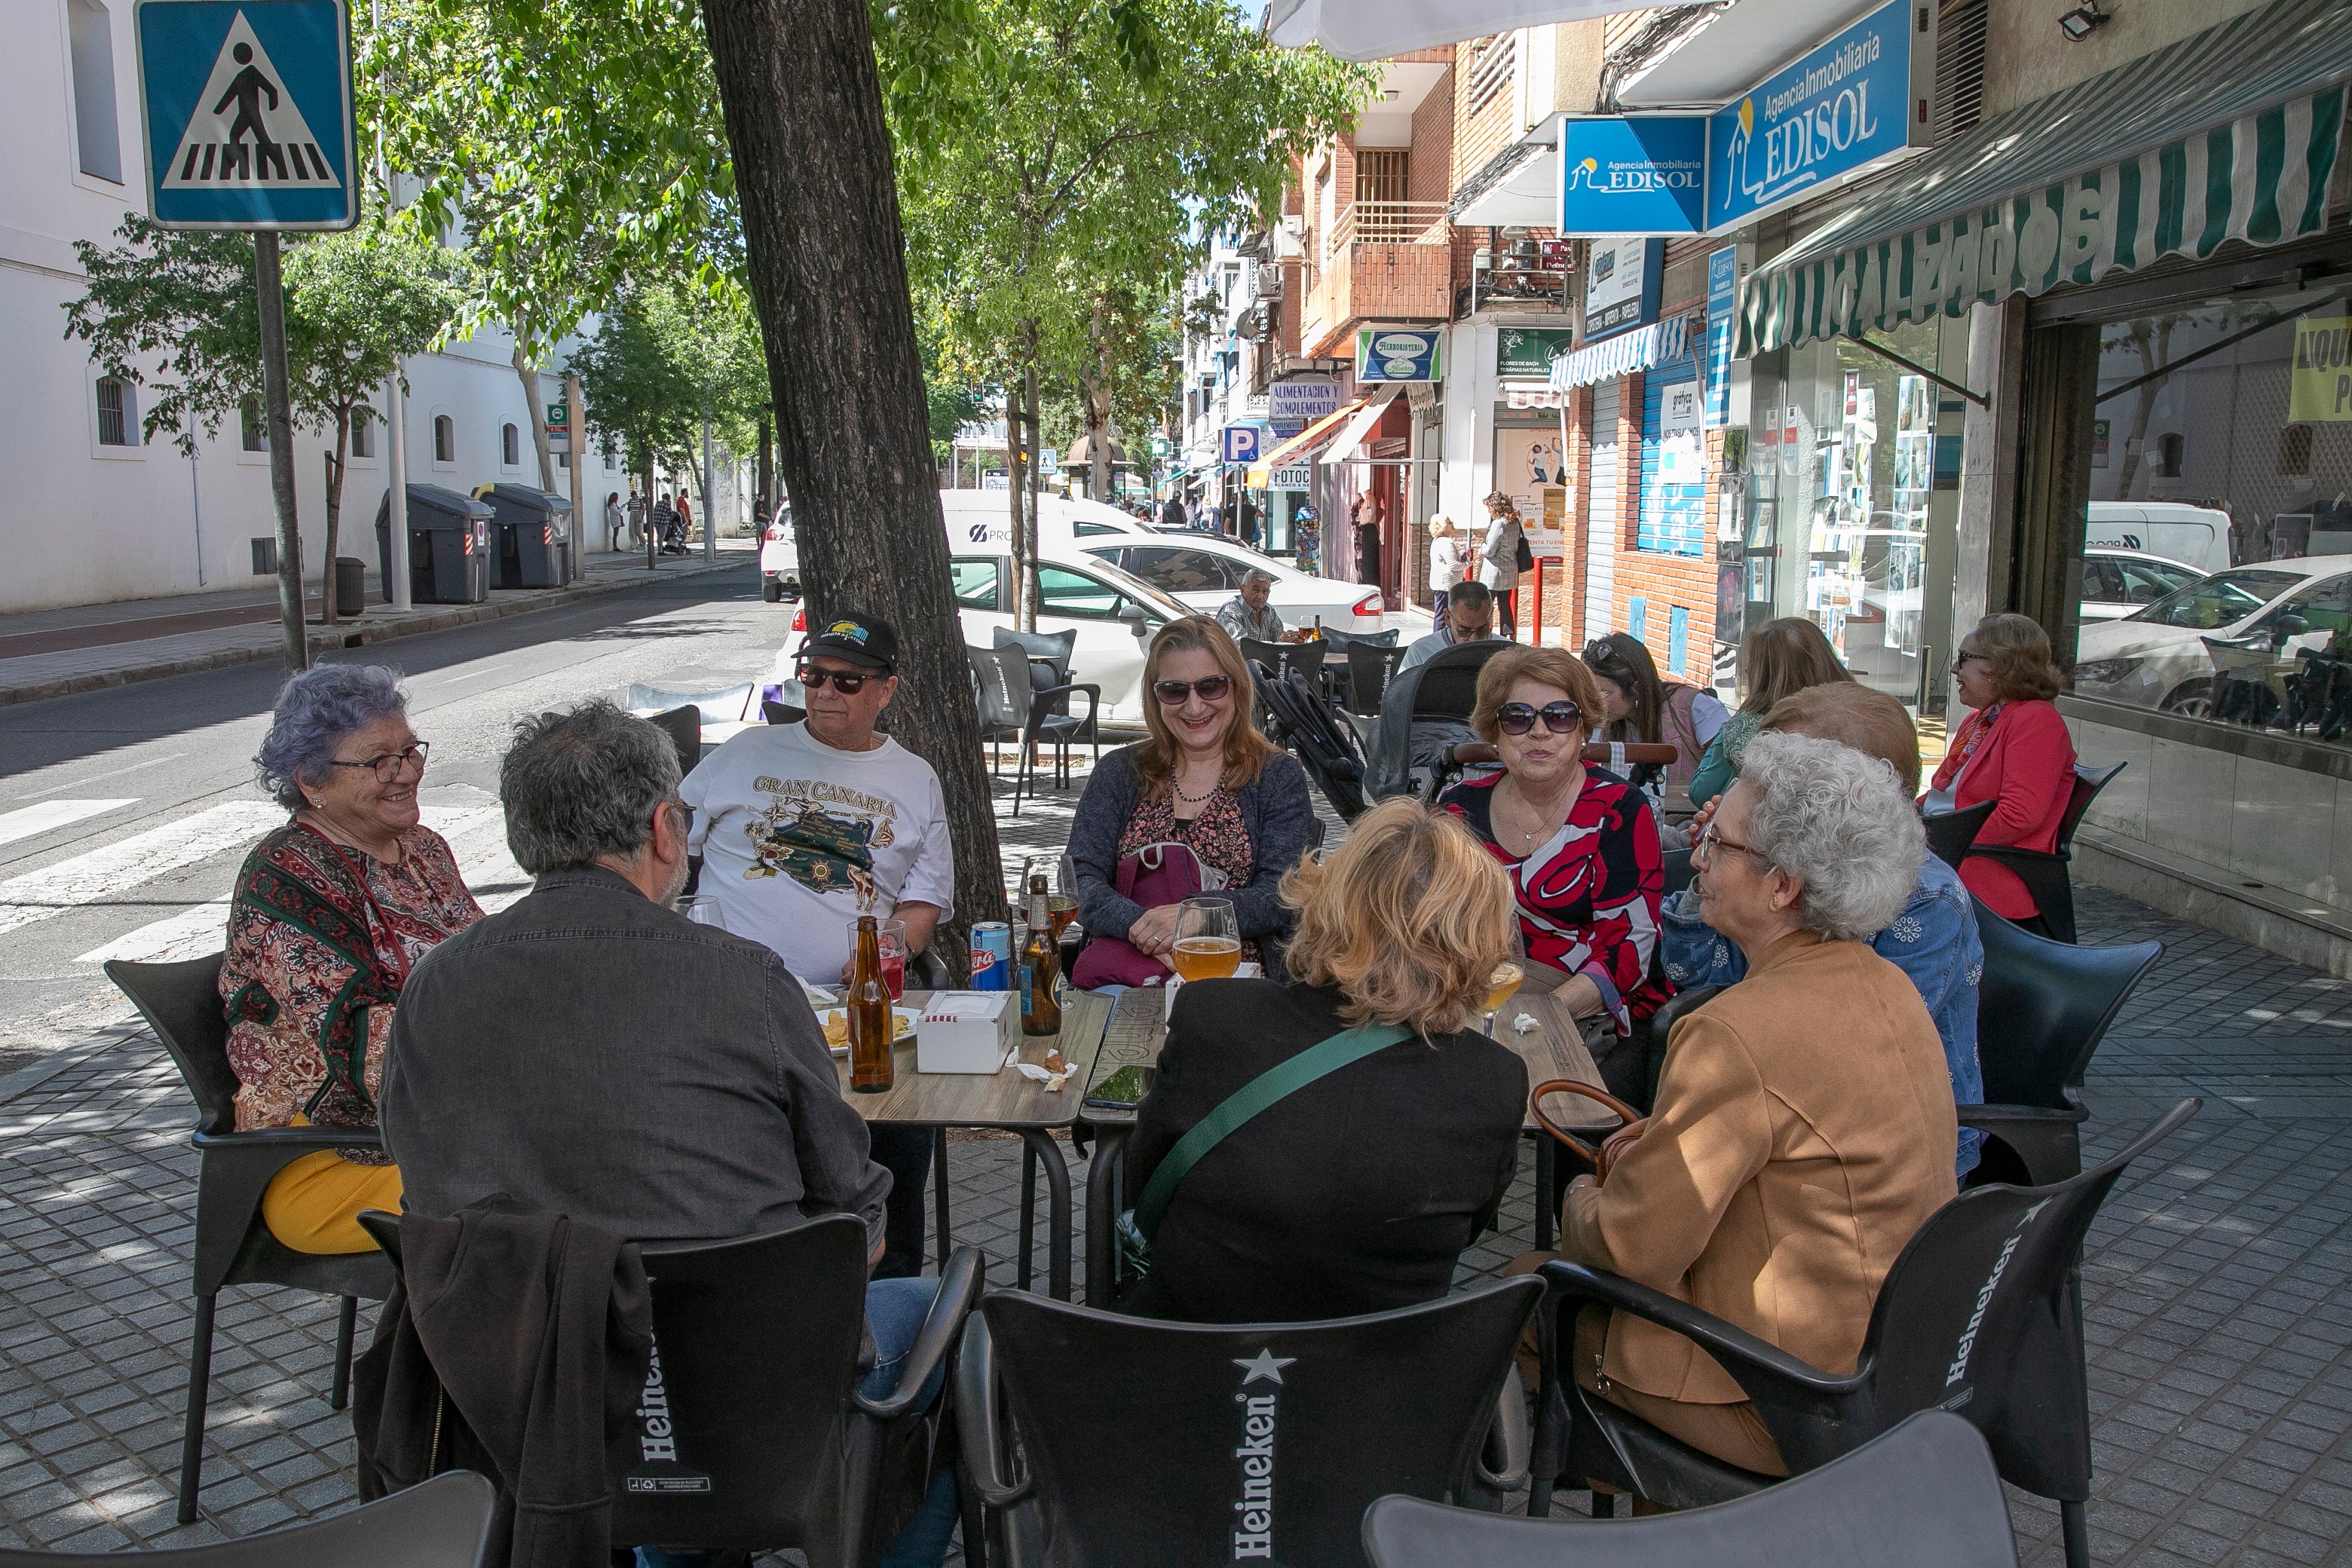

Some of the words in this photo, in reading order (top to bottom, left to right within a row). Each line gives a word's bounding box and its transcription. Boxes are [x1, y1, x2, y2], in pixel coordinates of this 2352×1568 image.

[1765, 78, 1878, 185] EDISOL
[1609, 171, 1701, 188] EDISOL
[1379, 341, 1424, 352] HERBORISTERIA
[1273, 385, 1330, 399] ALIMENTACION
[1334, 385, 1339, 399] Y
[2335, 374, 2352, 414] P
[1276, 402, 1337, 415] COMPLEMENTOS
[1230, 430, 1253, 461] P
[753, 776, 810, 798] GRAN
[811, 781, 898, 819] CANARIA
